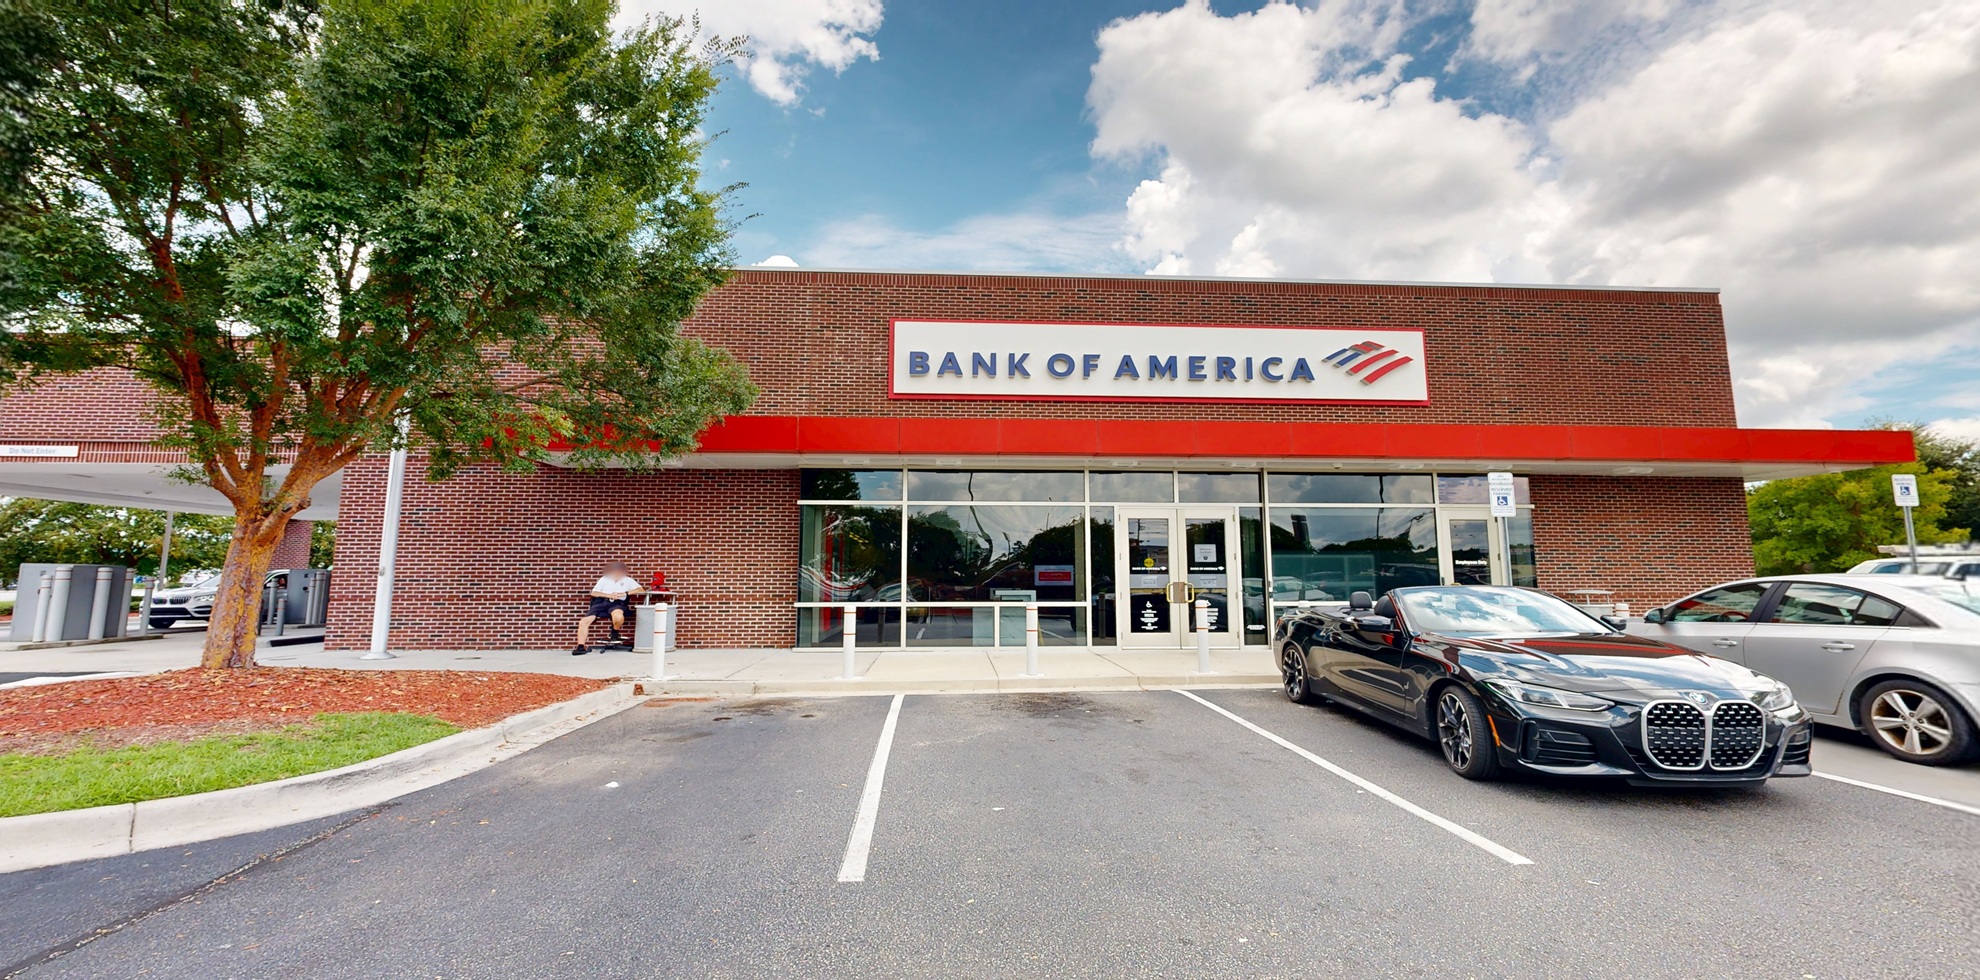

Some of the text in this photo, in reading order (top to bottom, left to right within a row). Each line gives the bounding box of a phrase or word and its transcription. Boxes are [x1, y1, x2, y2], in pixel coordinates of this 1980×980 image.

[909, 351, 1316, 383] BANK OF AMERICA
